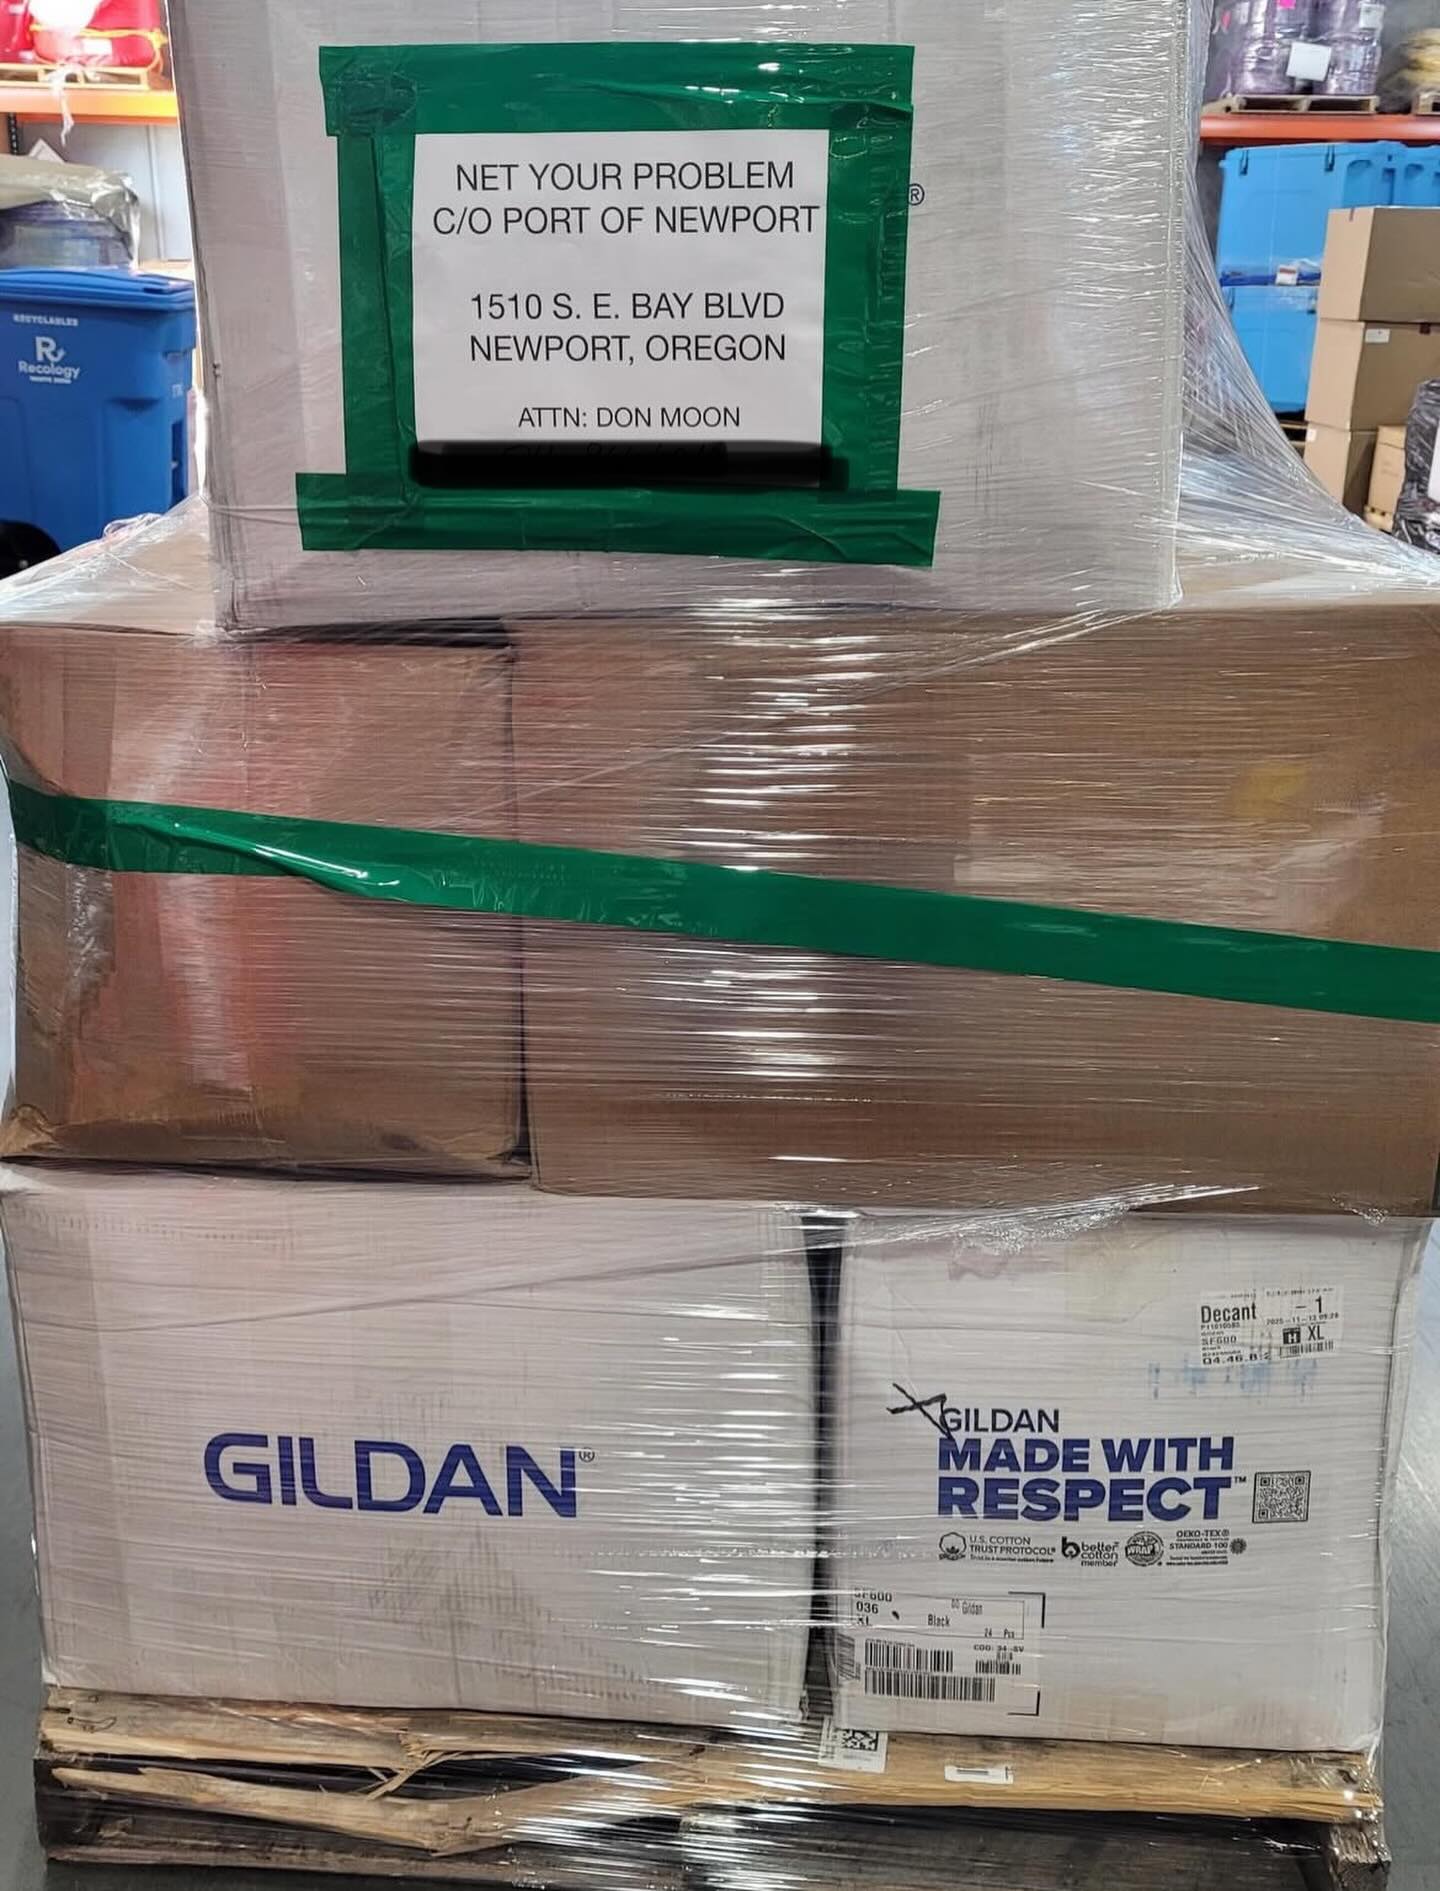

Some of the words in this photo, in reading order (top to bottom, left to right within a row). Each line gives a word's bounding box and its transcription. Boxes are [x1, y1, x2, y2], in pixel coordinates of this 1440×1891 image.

[456, 163, 520, 191] NET
[528, 162, 622, 191] YOUR
[634, 160, 794, 190] PROBLEM
[433, 206, 492, 235] C/O
[503, 206, 591, 234] PORT
[600, 206, 645, 234] OF
[655, 204, 821, 234] NEWPORT
[471, 293, 542, 320] 1510
[552, 293, 581, 320] S.
[593, 293, 620, 319] E.
[631, 292, 694, 319] BAY
[704, 292, 785, 319] BLVD
[470, 334, 634, 366] NEWPORT,
[645, 334, 786, 362] OREGON
[18, 360, 81, 379] Recology
[518, 407, 587, 428] ATTN:
[596, 406, 652, 428] DON
[660, 406, 740, 427] MOON
[1201, 1301, 1257, 1323] Decant
[1308, 1325, 1325, 1341] XL
[939, 1408, 1060, 1433] GILDAN
[939, 1438, 1091, 1473] MADE
[1102, 1437, 1235, 1473] WITH
[969, 1535, 987, 1544] U.S.
[989, 1535, 1031, 1545] COTTON
[970, 1544, 997, 1554] TRUST
[1169, 1542, 1212, 1550] STANDARD
[1214, 1541, 1228, 1549] 100
[1081, 1551, 1119, 1560] cotton
[1081, 1559, 1118, 1567] member
[856, 1601, 879, 1614] 036
[927, 1613, 950, 1627] Black
